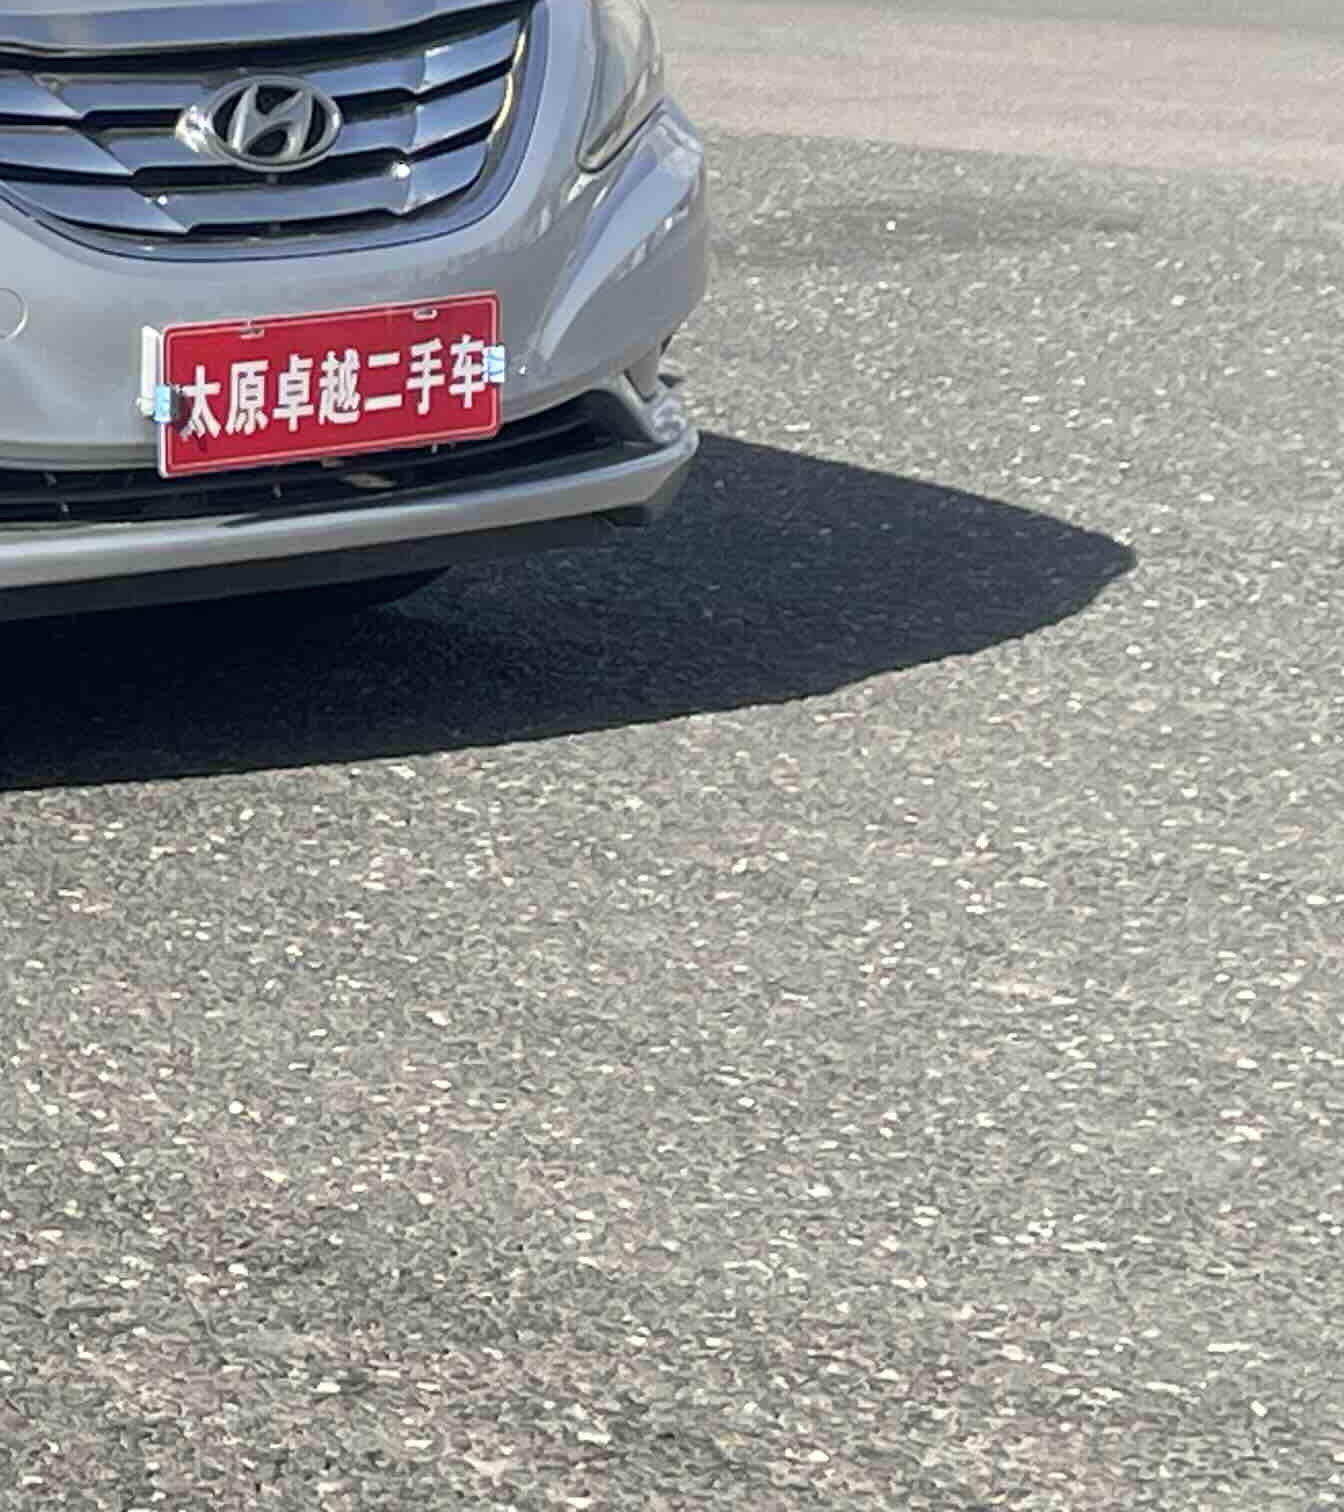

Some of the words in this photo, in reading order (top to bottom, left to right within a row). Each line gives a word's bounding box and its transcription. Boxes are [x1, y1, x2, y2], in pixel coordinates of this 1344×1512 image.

[181, 334, 486, 440] 太原卓越二手车
